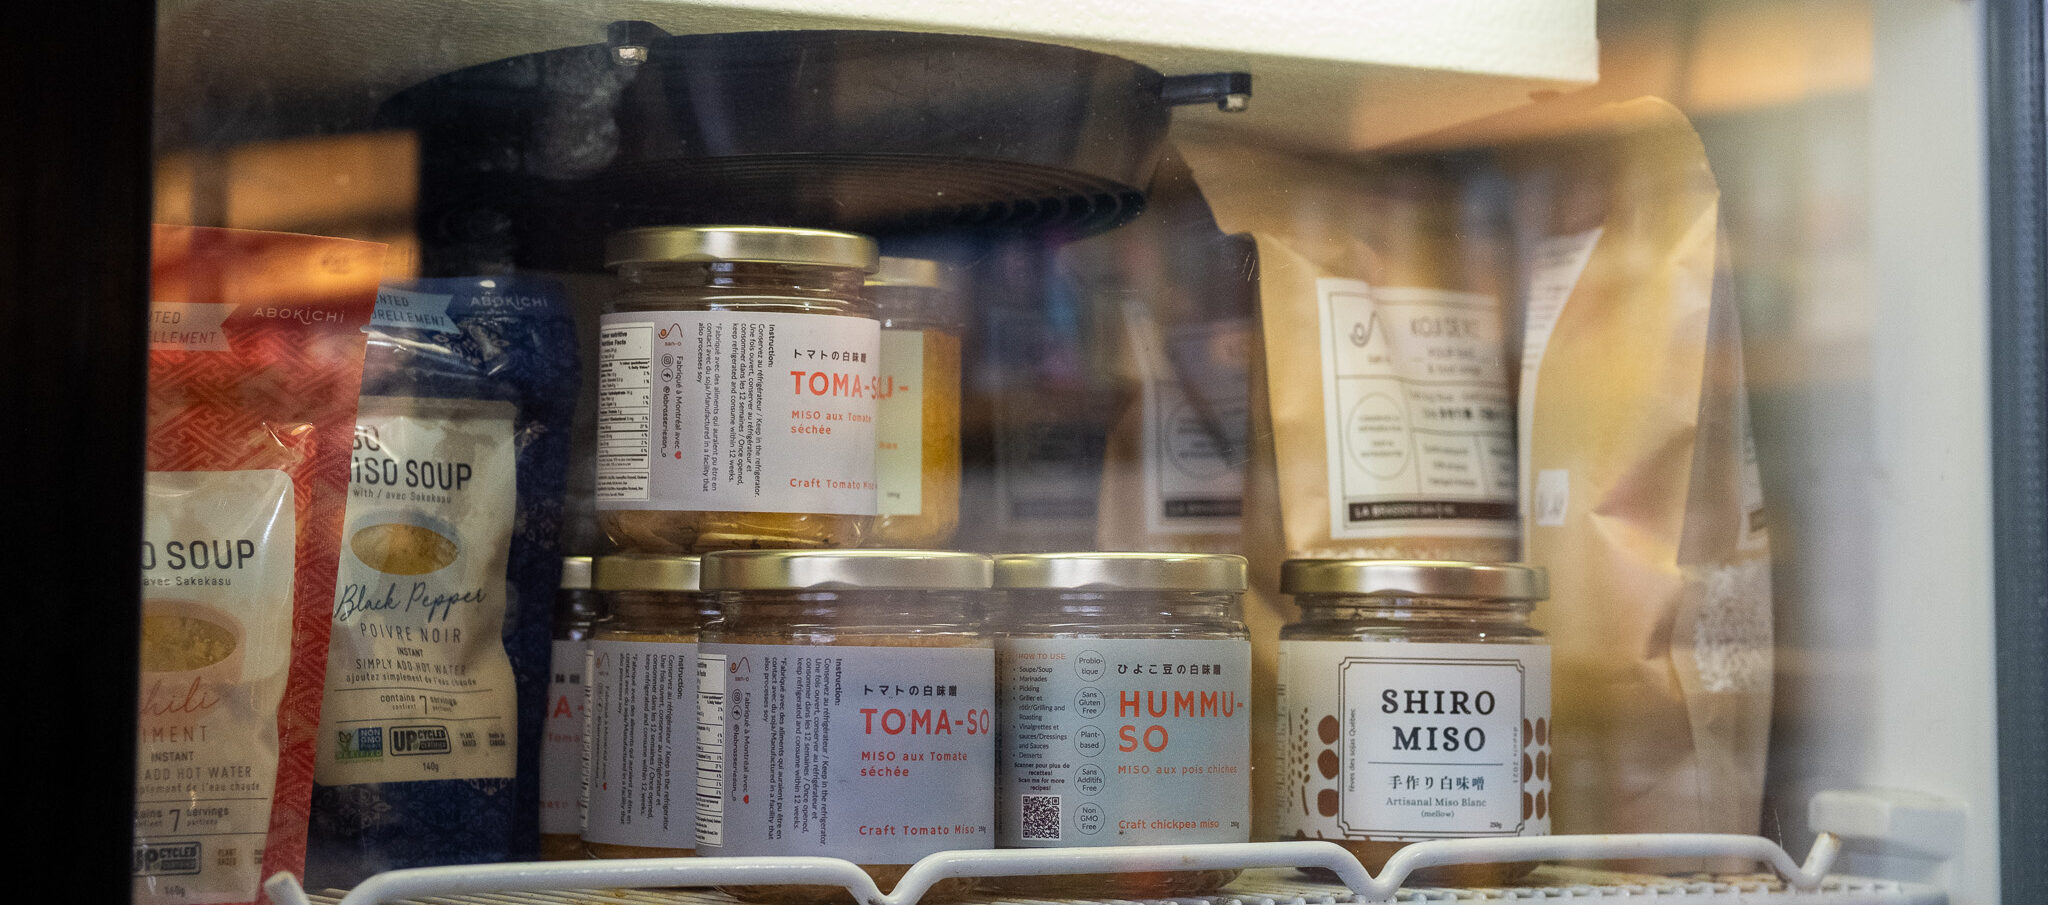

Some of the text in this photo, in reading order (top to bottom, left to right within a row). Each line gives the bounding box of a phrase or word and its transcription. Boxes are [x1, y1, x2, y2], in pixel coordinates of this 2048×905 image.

[757, 360, 762, 368] au
[675, 356, 683, 388] Fabriqué
[754, 369, 764, 411] réfrigérateur
[747, 412, 753, 420] au
[792, 410, 820, 419] MISO
[791, 424, 831, 434] séchée
[745, 422, 754, 463] réfrigérateur
[349, 457, 472, 490] ISO SOUP
[790, 479, 820, 488] Craft
[827, 480, 860, 489] Tomato
[354, 488, 374, 497] with
[386, 491, 406, 500] avec
[167, 540, 254, 569] SOUP
[335, 582, 486, 622] Black Pepper
[361, 623, 460, 643] POIVRE NOIR
[397, 647, 423, 657] INSTANT
[356, 659, 465, 676] SIMPLY ADD HOT WATER
[346, 672, 379, 684] ajoutez
[383, 673, 422, 682] simplement
[381, 694, 415, 702] contains
[420, 696, 427, 714] 7
[1120, 690, 1243, 717] HUMMU-
[1382, 689, 1495, 715] SHIRO
[860, 708, 989, 735] TOMA-SO
[1119, 725, 1168, 752] SO
[1392, 726, 1485, 751] MISO
[1348, 739, 1356, 757] sojas
[151, 751, 193, 761] INSTANT
[862, 752, 896, 760] MISO
[931, 752, 967, 760] Tomate
[861, 766, 909, 776] séchée
[1118, 766, 1149, 774] MISO
[1182, 765, 1203, 776] pois
[1208, 764, 1237, 774] chiches
[1348, 758, 1356, 771] des
[145, 766, 251, 780] ADD HOT WATER
[1390, 775, 1485, 791] 手作り白味噌
[1386, 798, 1486, 807] Artisanal Miso Blanc
[169, 809, 180, 832] 7
[1421, 810, 1454, 818] (mellow)
[859, 825, 896, 835] Craft
[904, 826, 949, 835] Tomato
[955, 825, 974, 834] Miso
[1119, 819, 1219, 830] Craft chickpea miso
